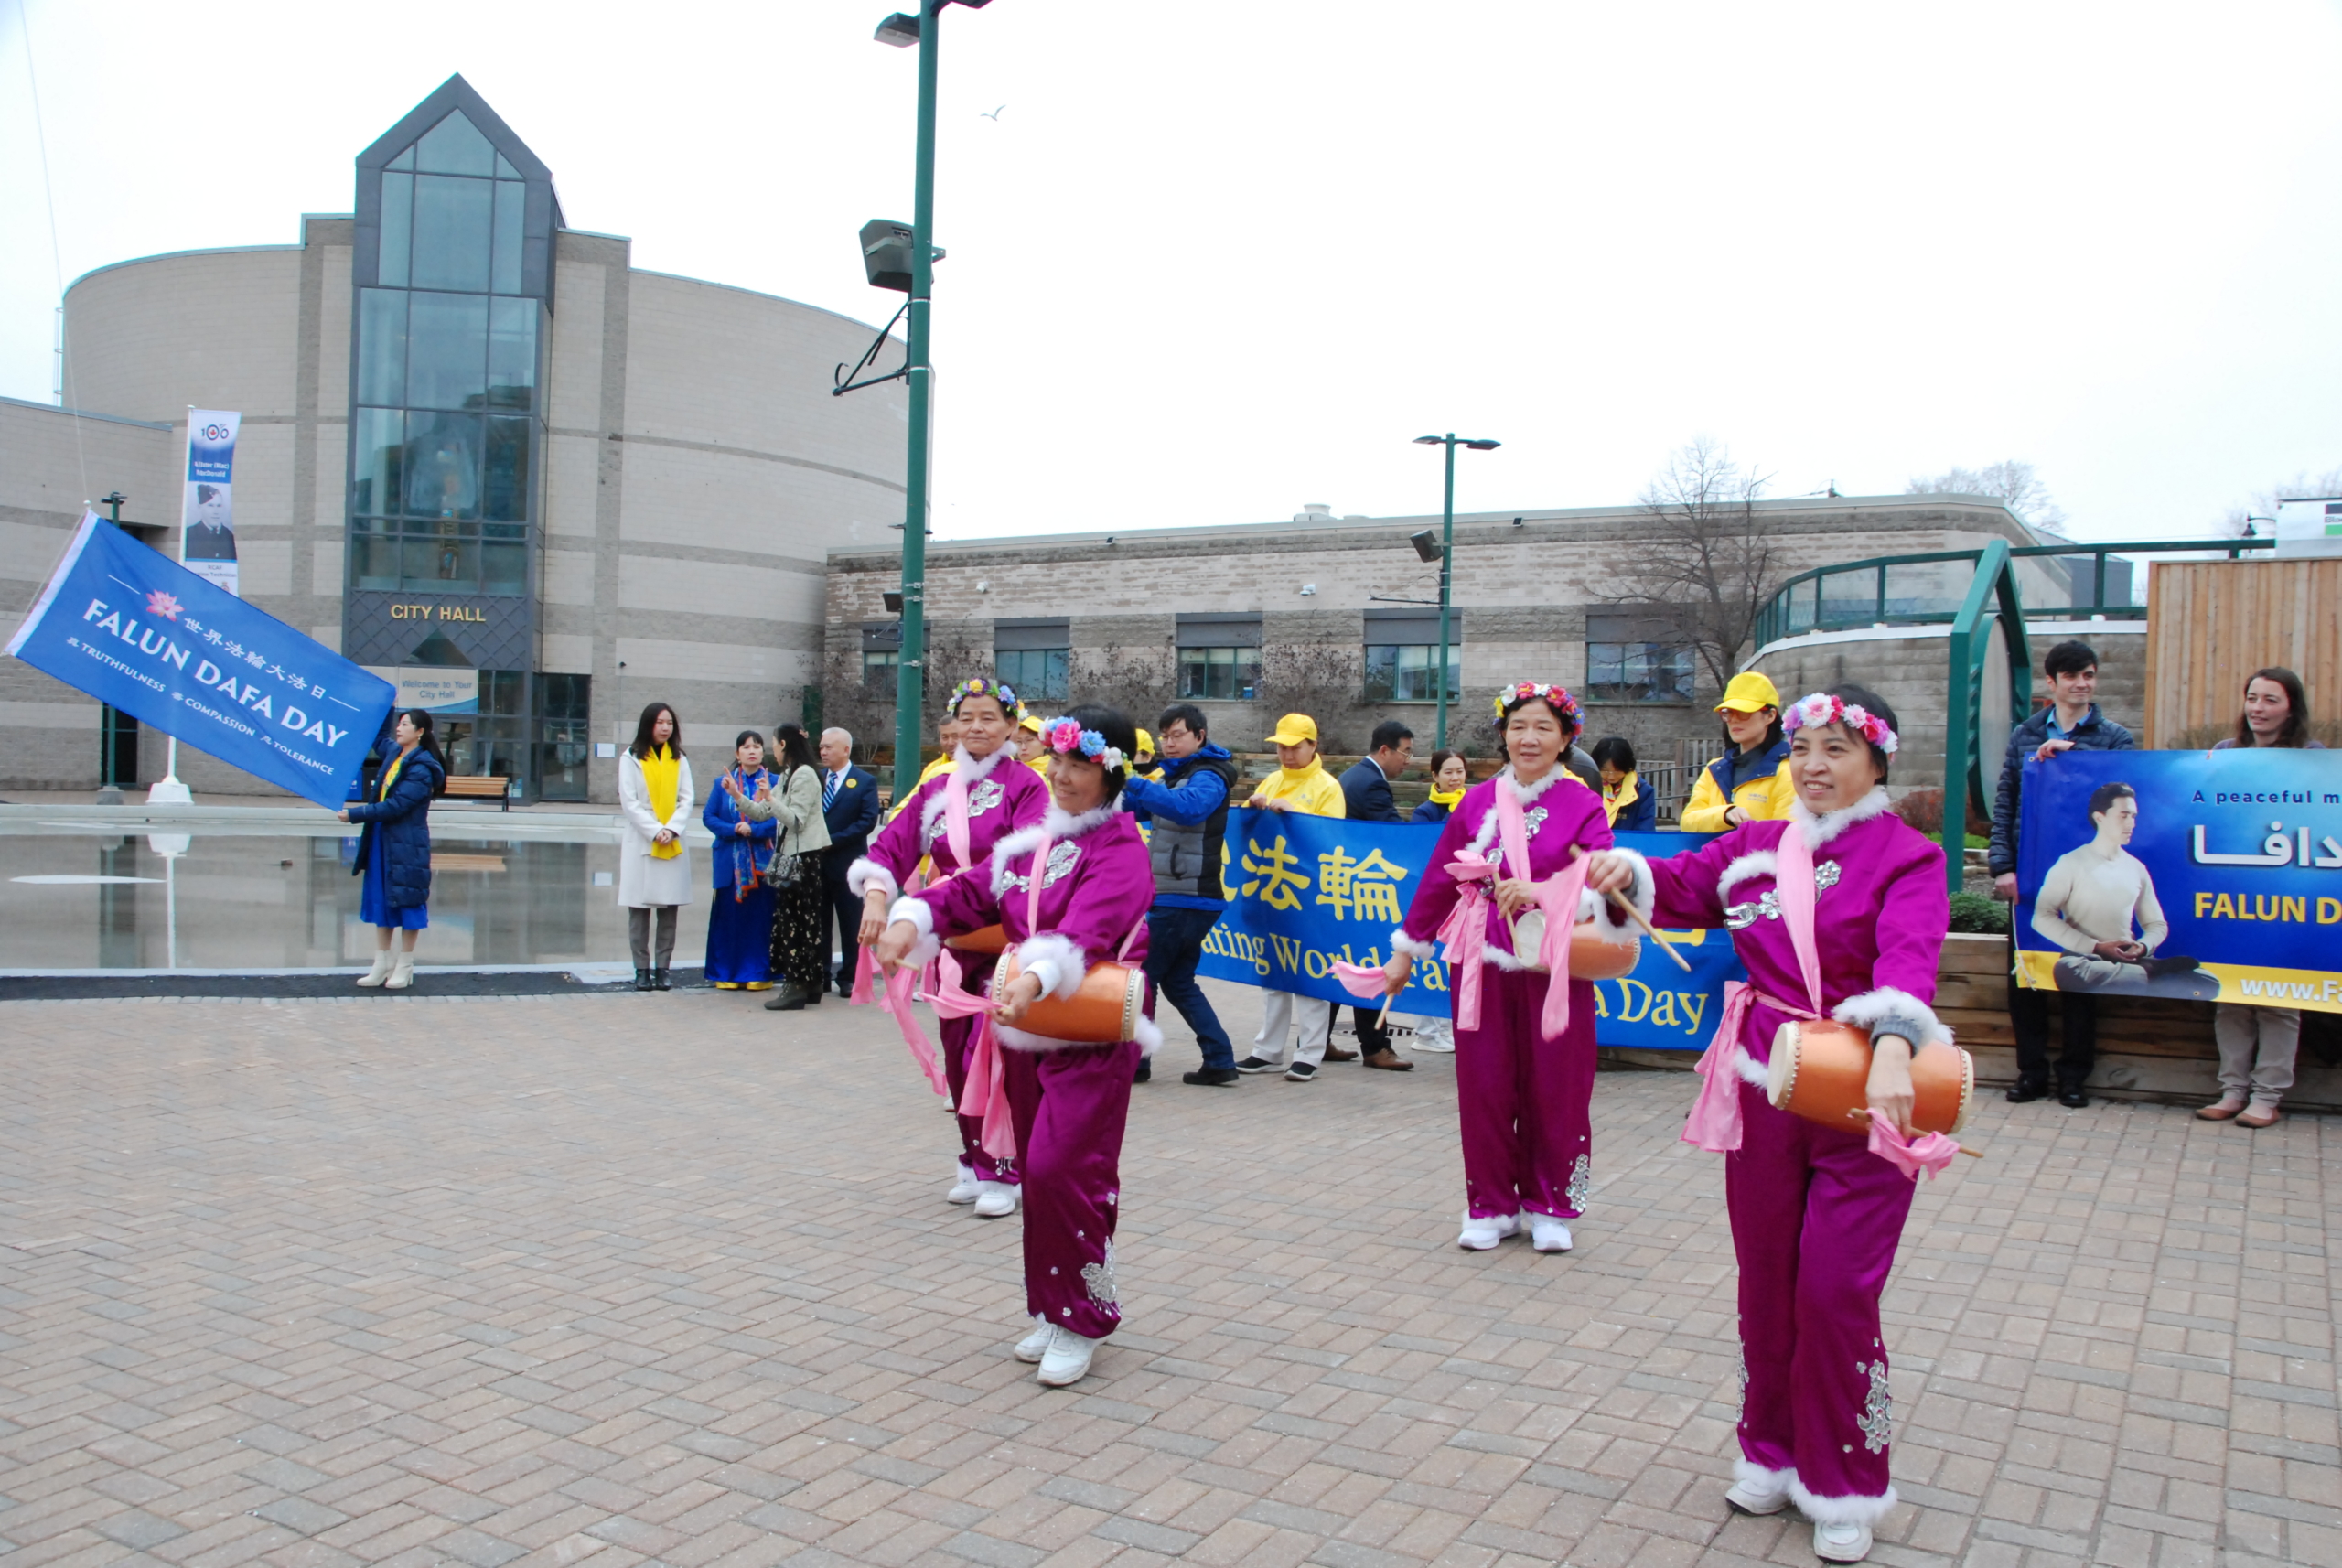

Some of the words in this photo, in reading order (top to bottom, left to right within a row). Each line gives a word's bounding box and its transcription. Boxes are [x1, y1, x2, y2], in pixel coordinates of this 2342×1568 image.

[391, 604, 433, 619] CITY
[440, 607, 486, 622] HALL
[184, 618, 327, 699] 世界法輪大法日
[82, 598, 191, 671] FALUN
[194, 659, 273, 719] DAFA
[280, 705, 349, 748] DAY
[401, 680, 440, 688] Welcome
[443, 680, 451, 688] to
[454, 681, 472, 689] Your
[81, 642, 166, 692] TRUTHFULNESS
[185, 698, 256, 736] COMPASSION
[274, 741, 335, 775] TOLERANCE
[419, 691, 436, 700] City
[439, 691, 455, 699] Hall
[2192, 790, 2205, 803] A
[2216, 790, 2313, 805] peaceful
[2195, 892, 2306, 923] FALUN
[1200, 922, 1271, 976] ating
[1616, 977, 1710, 1035] Day
[2240, 979, 2342, 1004] www.F
